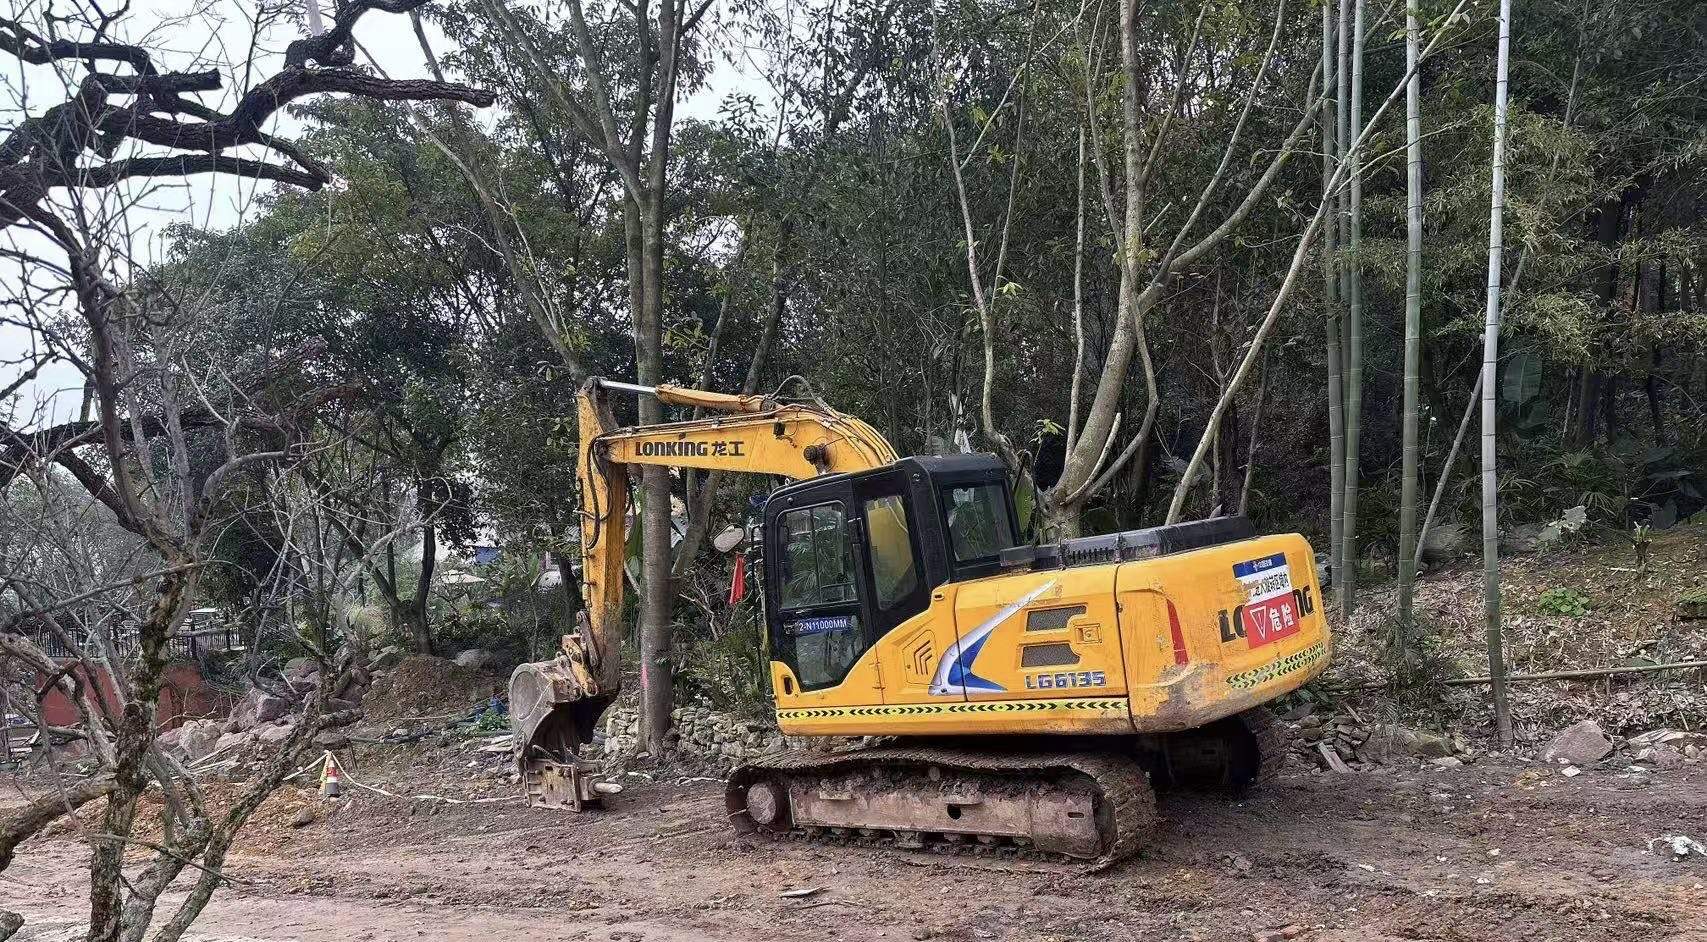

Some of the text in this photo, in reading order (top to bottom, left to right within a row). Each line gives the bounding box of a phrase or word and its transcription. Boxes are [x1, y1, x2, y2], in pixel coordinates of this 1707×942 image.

[635, 441, 746, 457] LONKING 龙工
[1269, 602, 1295, 633] 危险
[1024, 671, 1107, 690] LG6135
